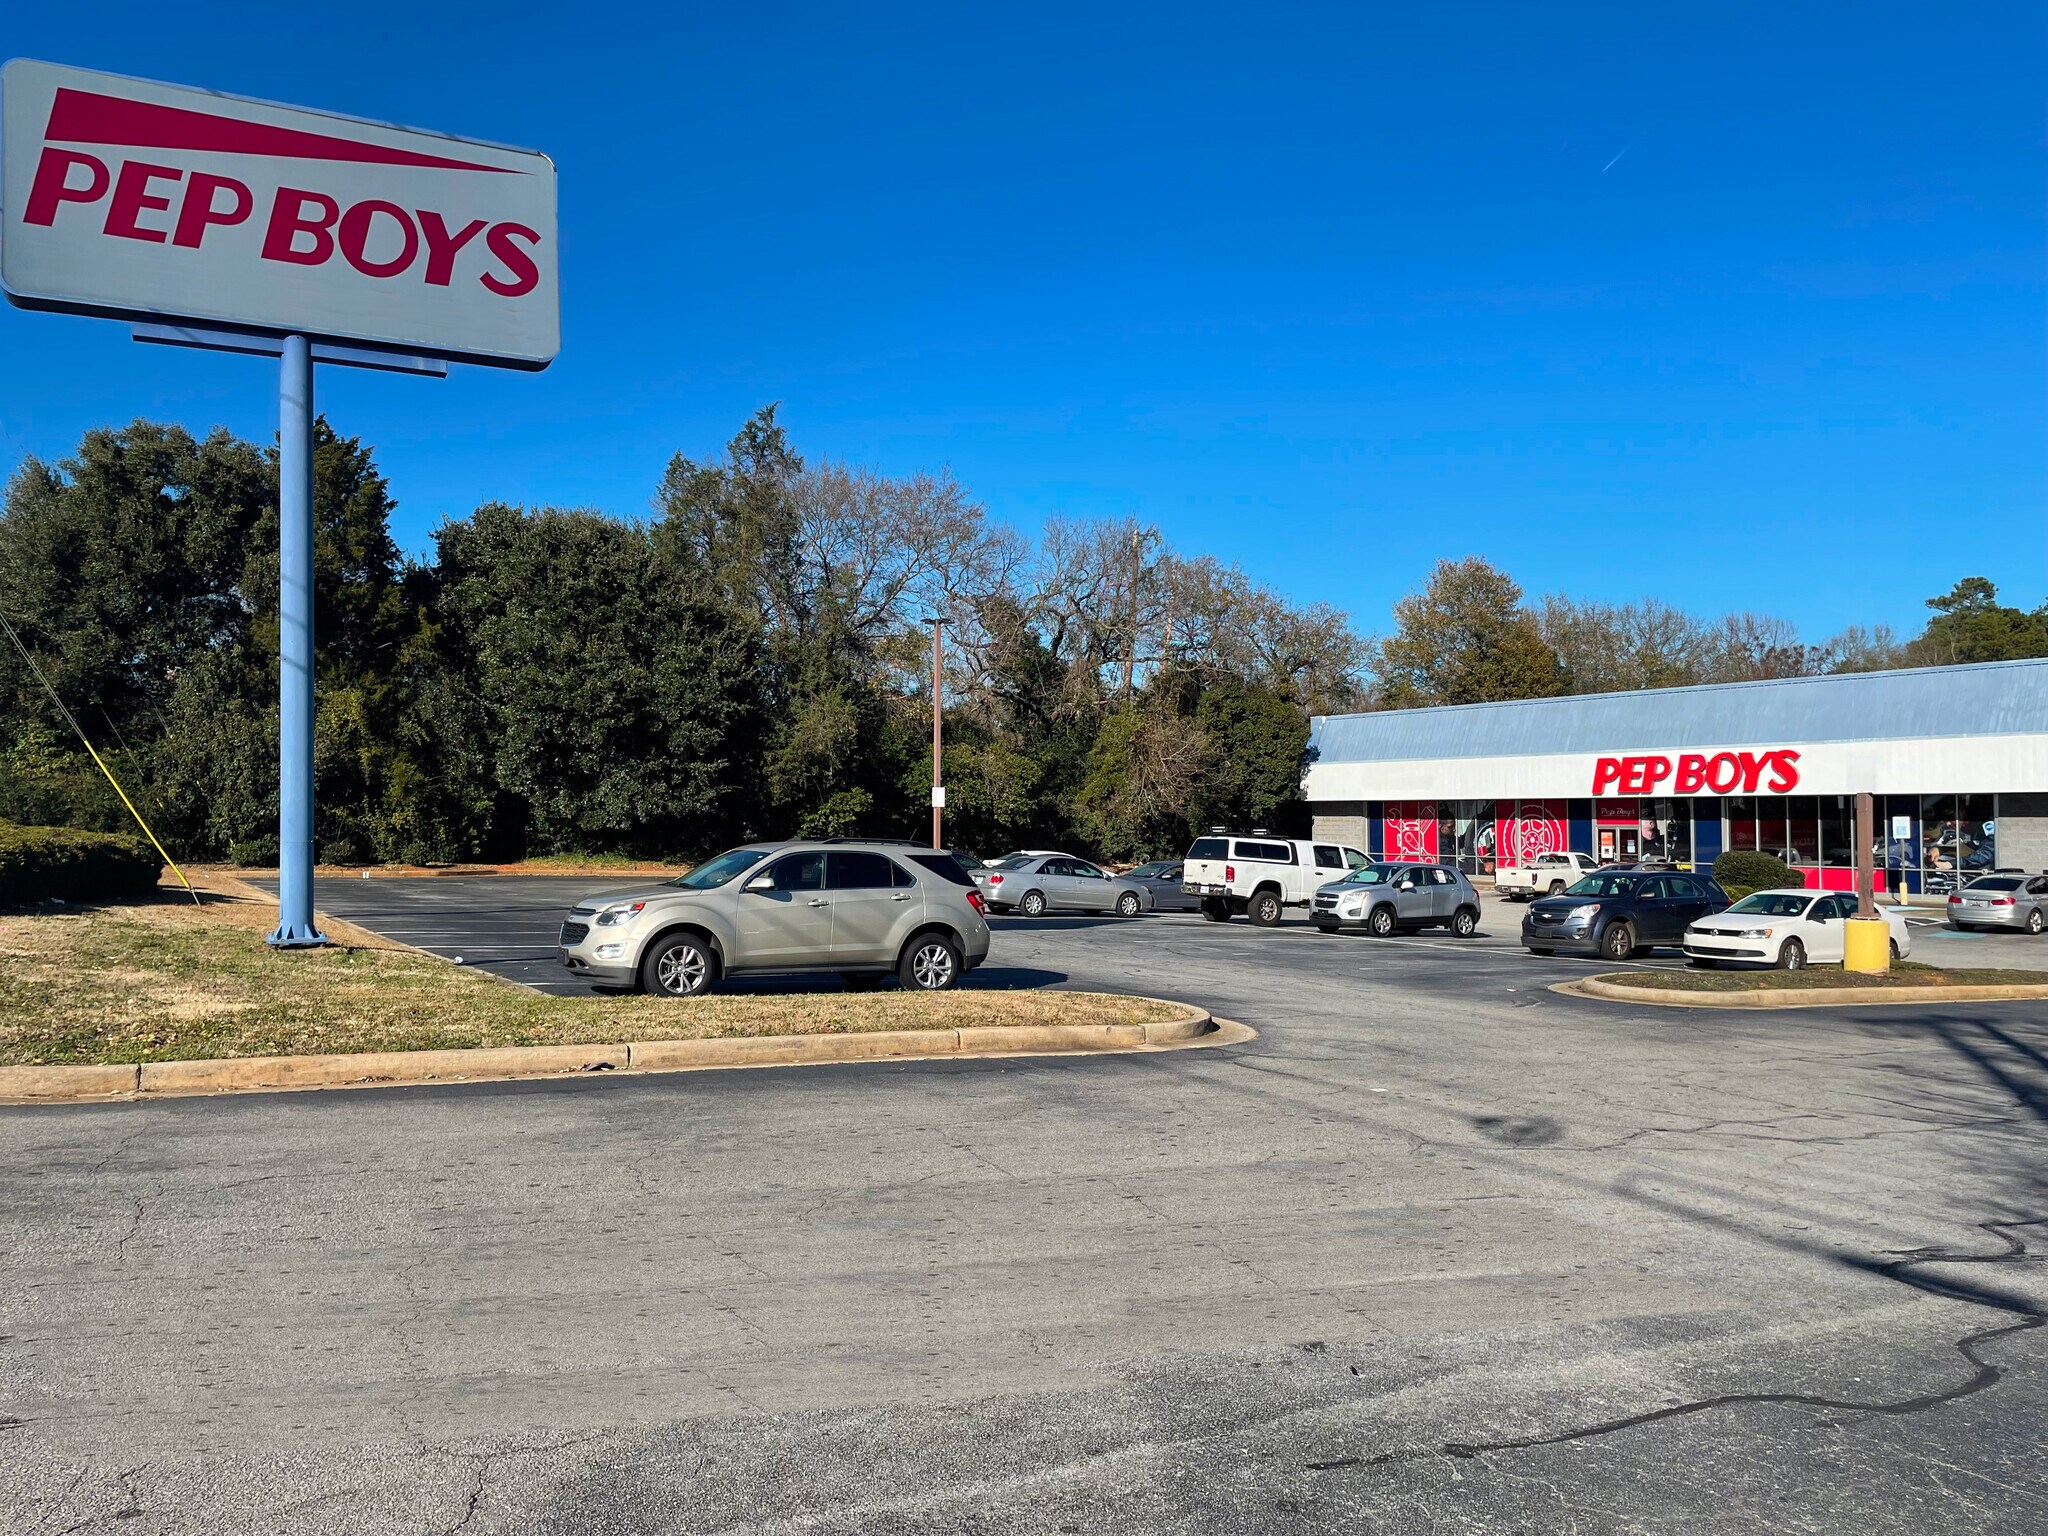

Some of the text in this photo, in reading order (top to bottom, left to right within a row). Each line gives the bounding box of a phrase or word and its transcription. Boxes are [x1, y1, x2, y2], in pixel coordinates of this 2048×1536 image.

[23, 146, 541, 297] PEP BOYS
[1592, 749, 1801, 795] PEP BOYS
